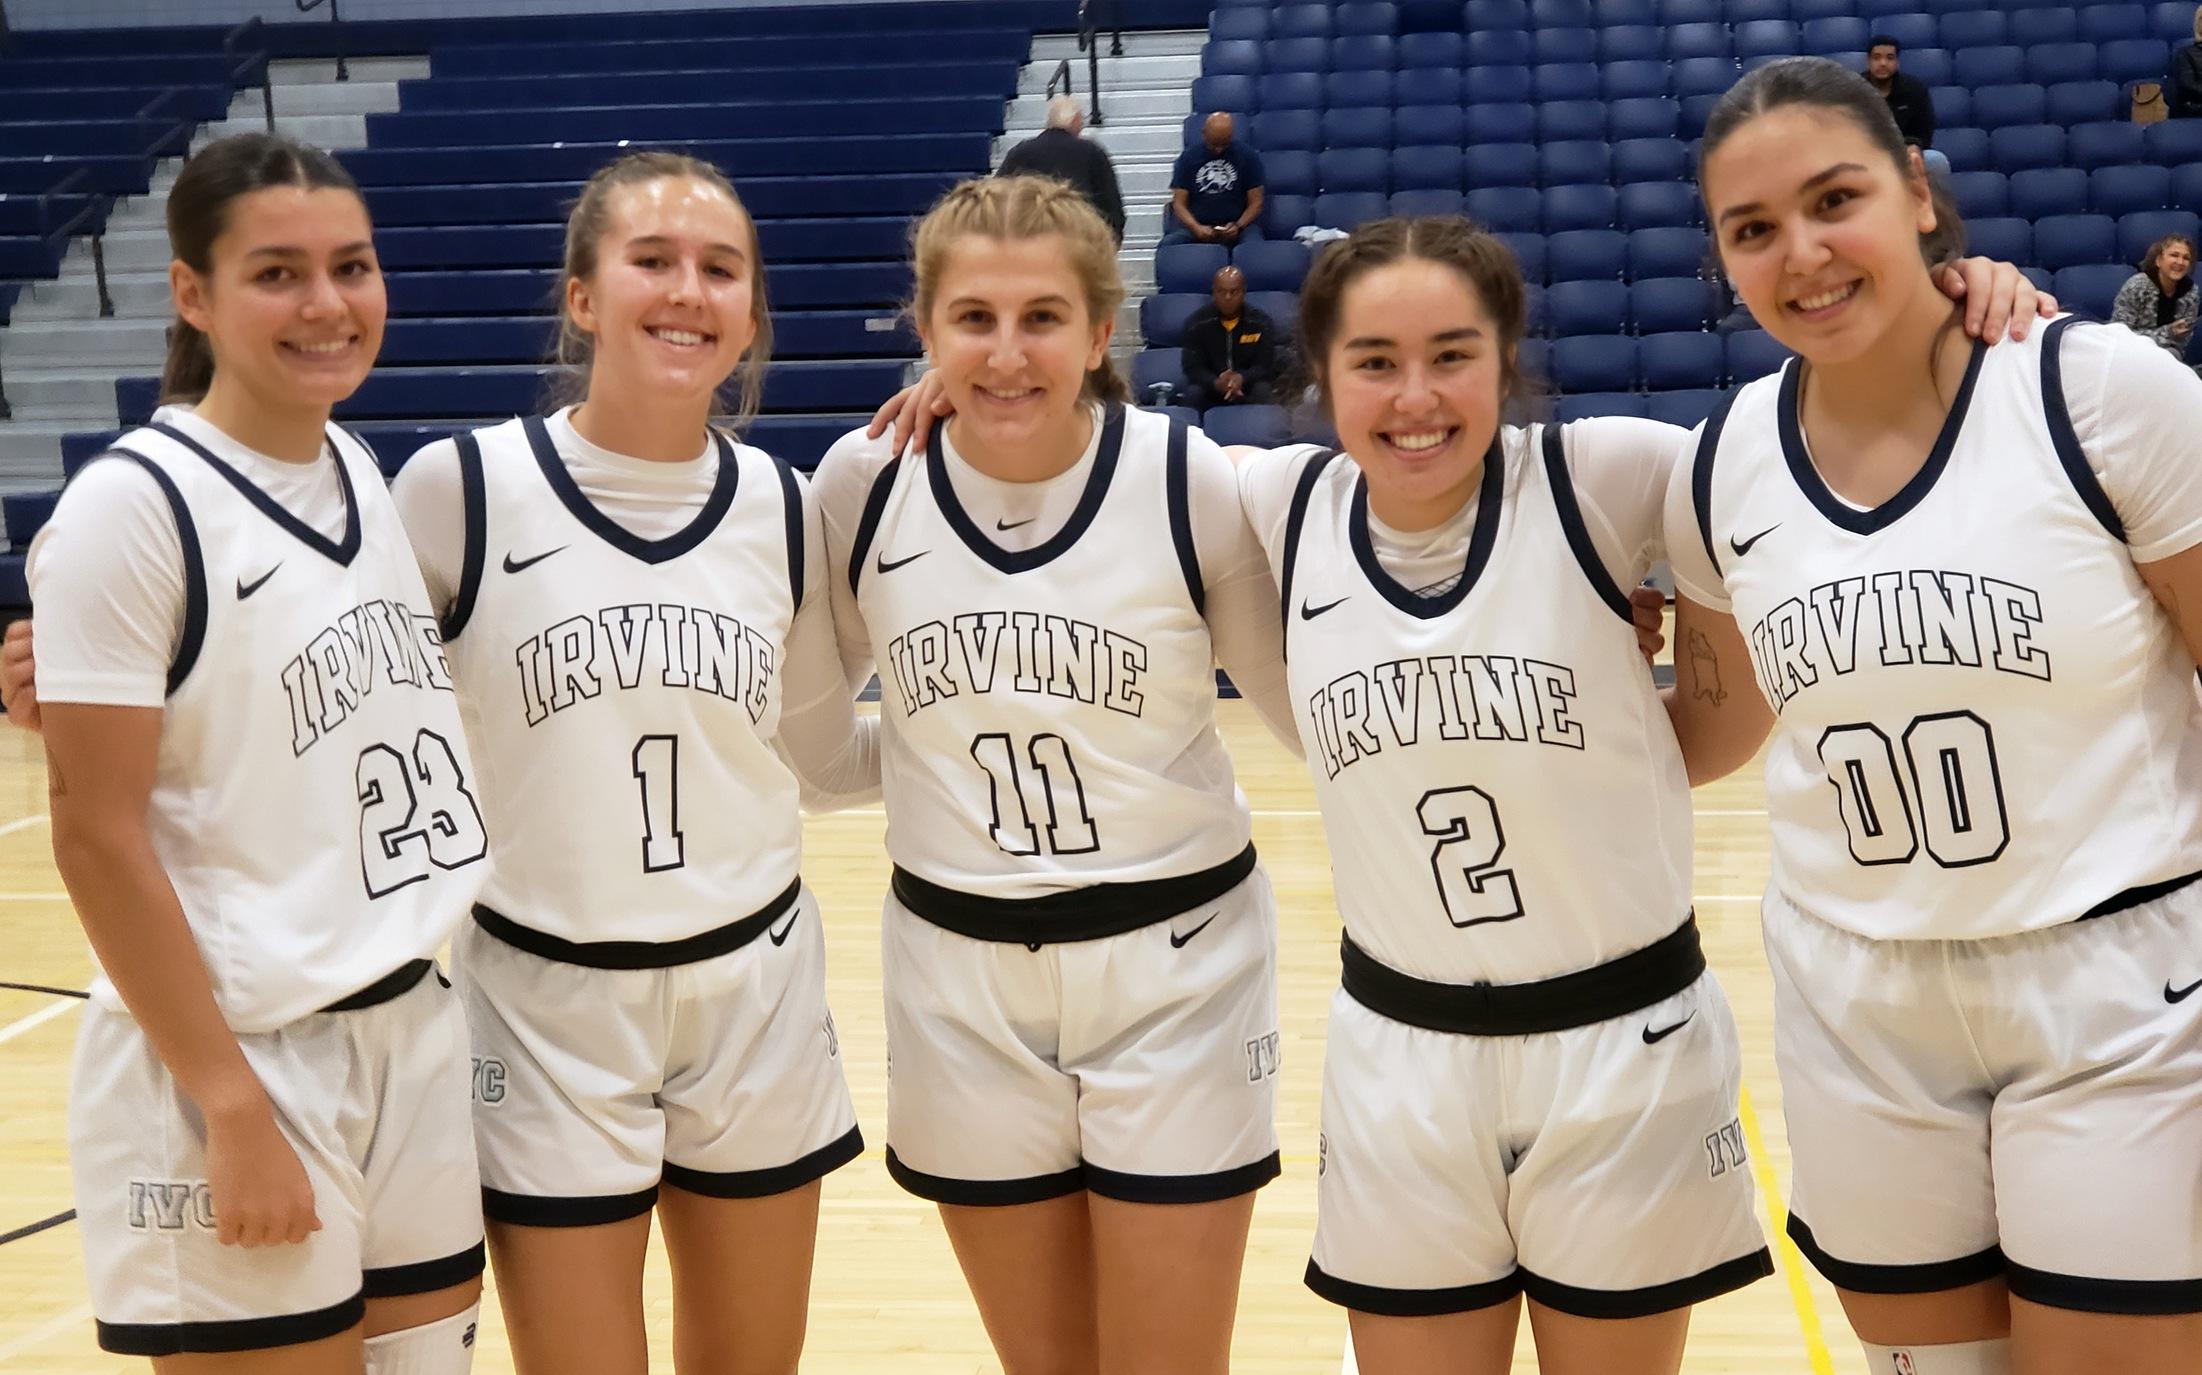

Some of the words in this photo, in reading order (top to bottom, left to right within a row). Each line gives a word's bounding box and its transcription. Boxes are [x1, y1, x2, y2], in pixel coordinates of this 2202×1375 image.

[515, 603, 775, 728] IRVINE
[888, 611, 1148, 718] IRVINE
[1752, 569, 2052, 716] IRVINE
[1309, 655, 1586, 782] IRVINE
[355, 727, 488, 901] 23
[631, 734, 685, 874] 1
[969, 732, 1101, 857] 11
[1816, 709, 2011, 869] 00
[1415, 784, 1526, 929] 2
[1246, 1031, 1282, 1081] IV
